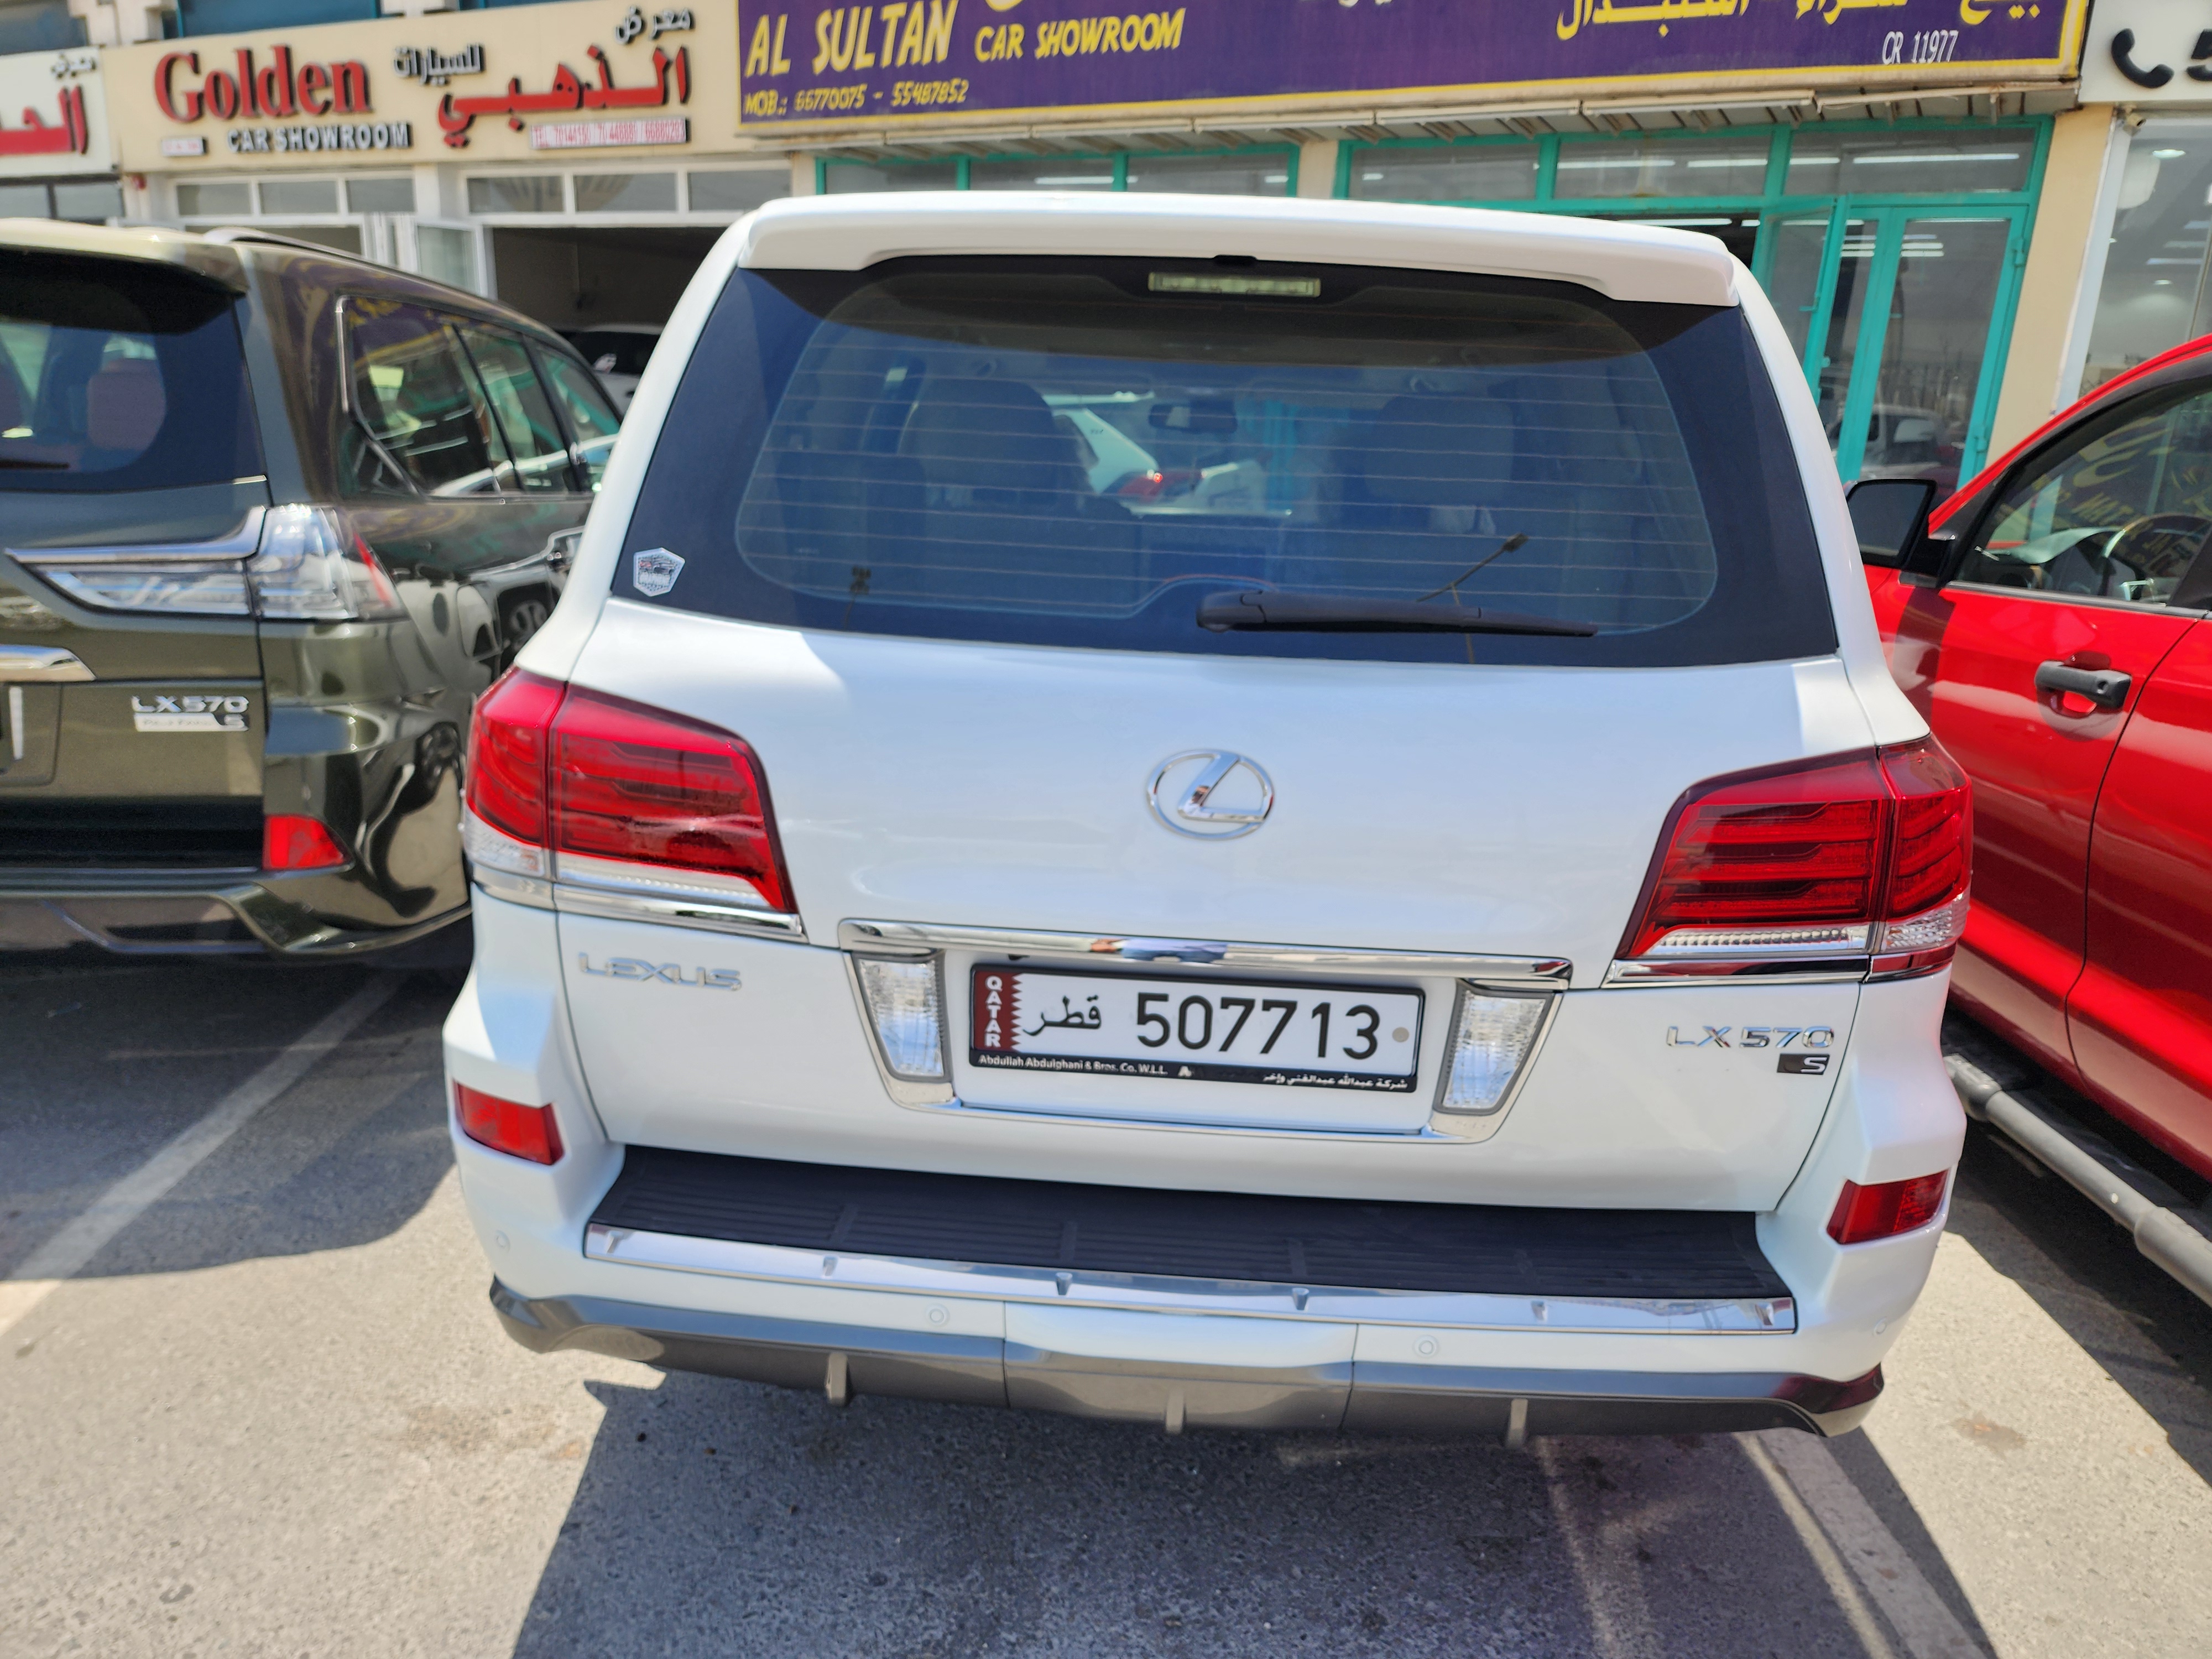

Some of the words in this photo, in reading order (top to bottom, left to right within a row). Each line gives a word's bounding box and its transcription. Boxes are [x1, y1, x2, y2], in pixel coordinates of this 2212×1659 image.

[614, 6, 691, 45] معرض
[744, 14, 791, 78] AL
[812, 0, 958, 75] SULTAN
[974, 24, 1023, 62] CAR
[1035, 8, 1186, 59] SHOWROOM
[394, 43, 482, 86] للسيارات
[1882, 31, 1904, 65] CR
[1911, 30, 1958, 64] 11977
[154, 44, 370, 123] Golden
[437, 44, 687, 147] الذهبي
[794, 83, 868, 111] 66770075
[891, 78, 969, 106] 55487852
[227, 128, 270, 153] CAR
[276, 123, 410, 153] SHOWROOM
[132, 695, 182, 713] LX
[182, 695, 249, 713] 570
[578, 952, 742, 990] LEXUS
[984, 975, 1003, 1047] QATAR
[1022, 995, 1102, 1036] قطر
[1136, 992, 1380, 1060] 507713
[1666, 1025, 1733, 1048] LX
[1739, 1025, 1834, 1049] 570
[978, 1054, 1023, 1067] Abdullah
[1025, 1057, 1083, 1071] Abdulghani
[1084, 1061, 1092, 1070] &
[1119, 1062, 1137, 1073] Co.
[1800, 1057, 1828, 1073] S
[1376, 1077, 1408, 1091] شركة
